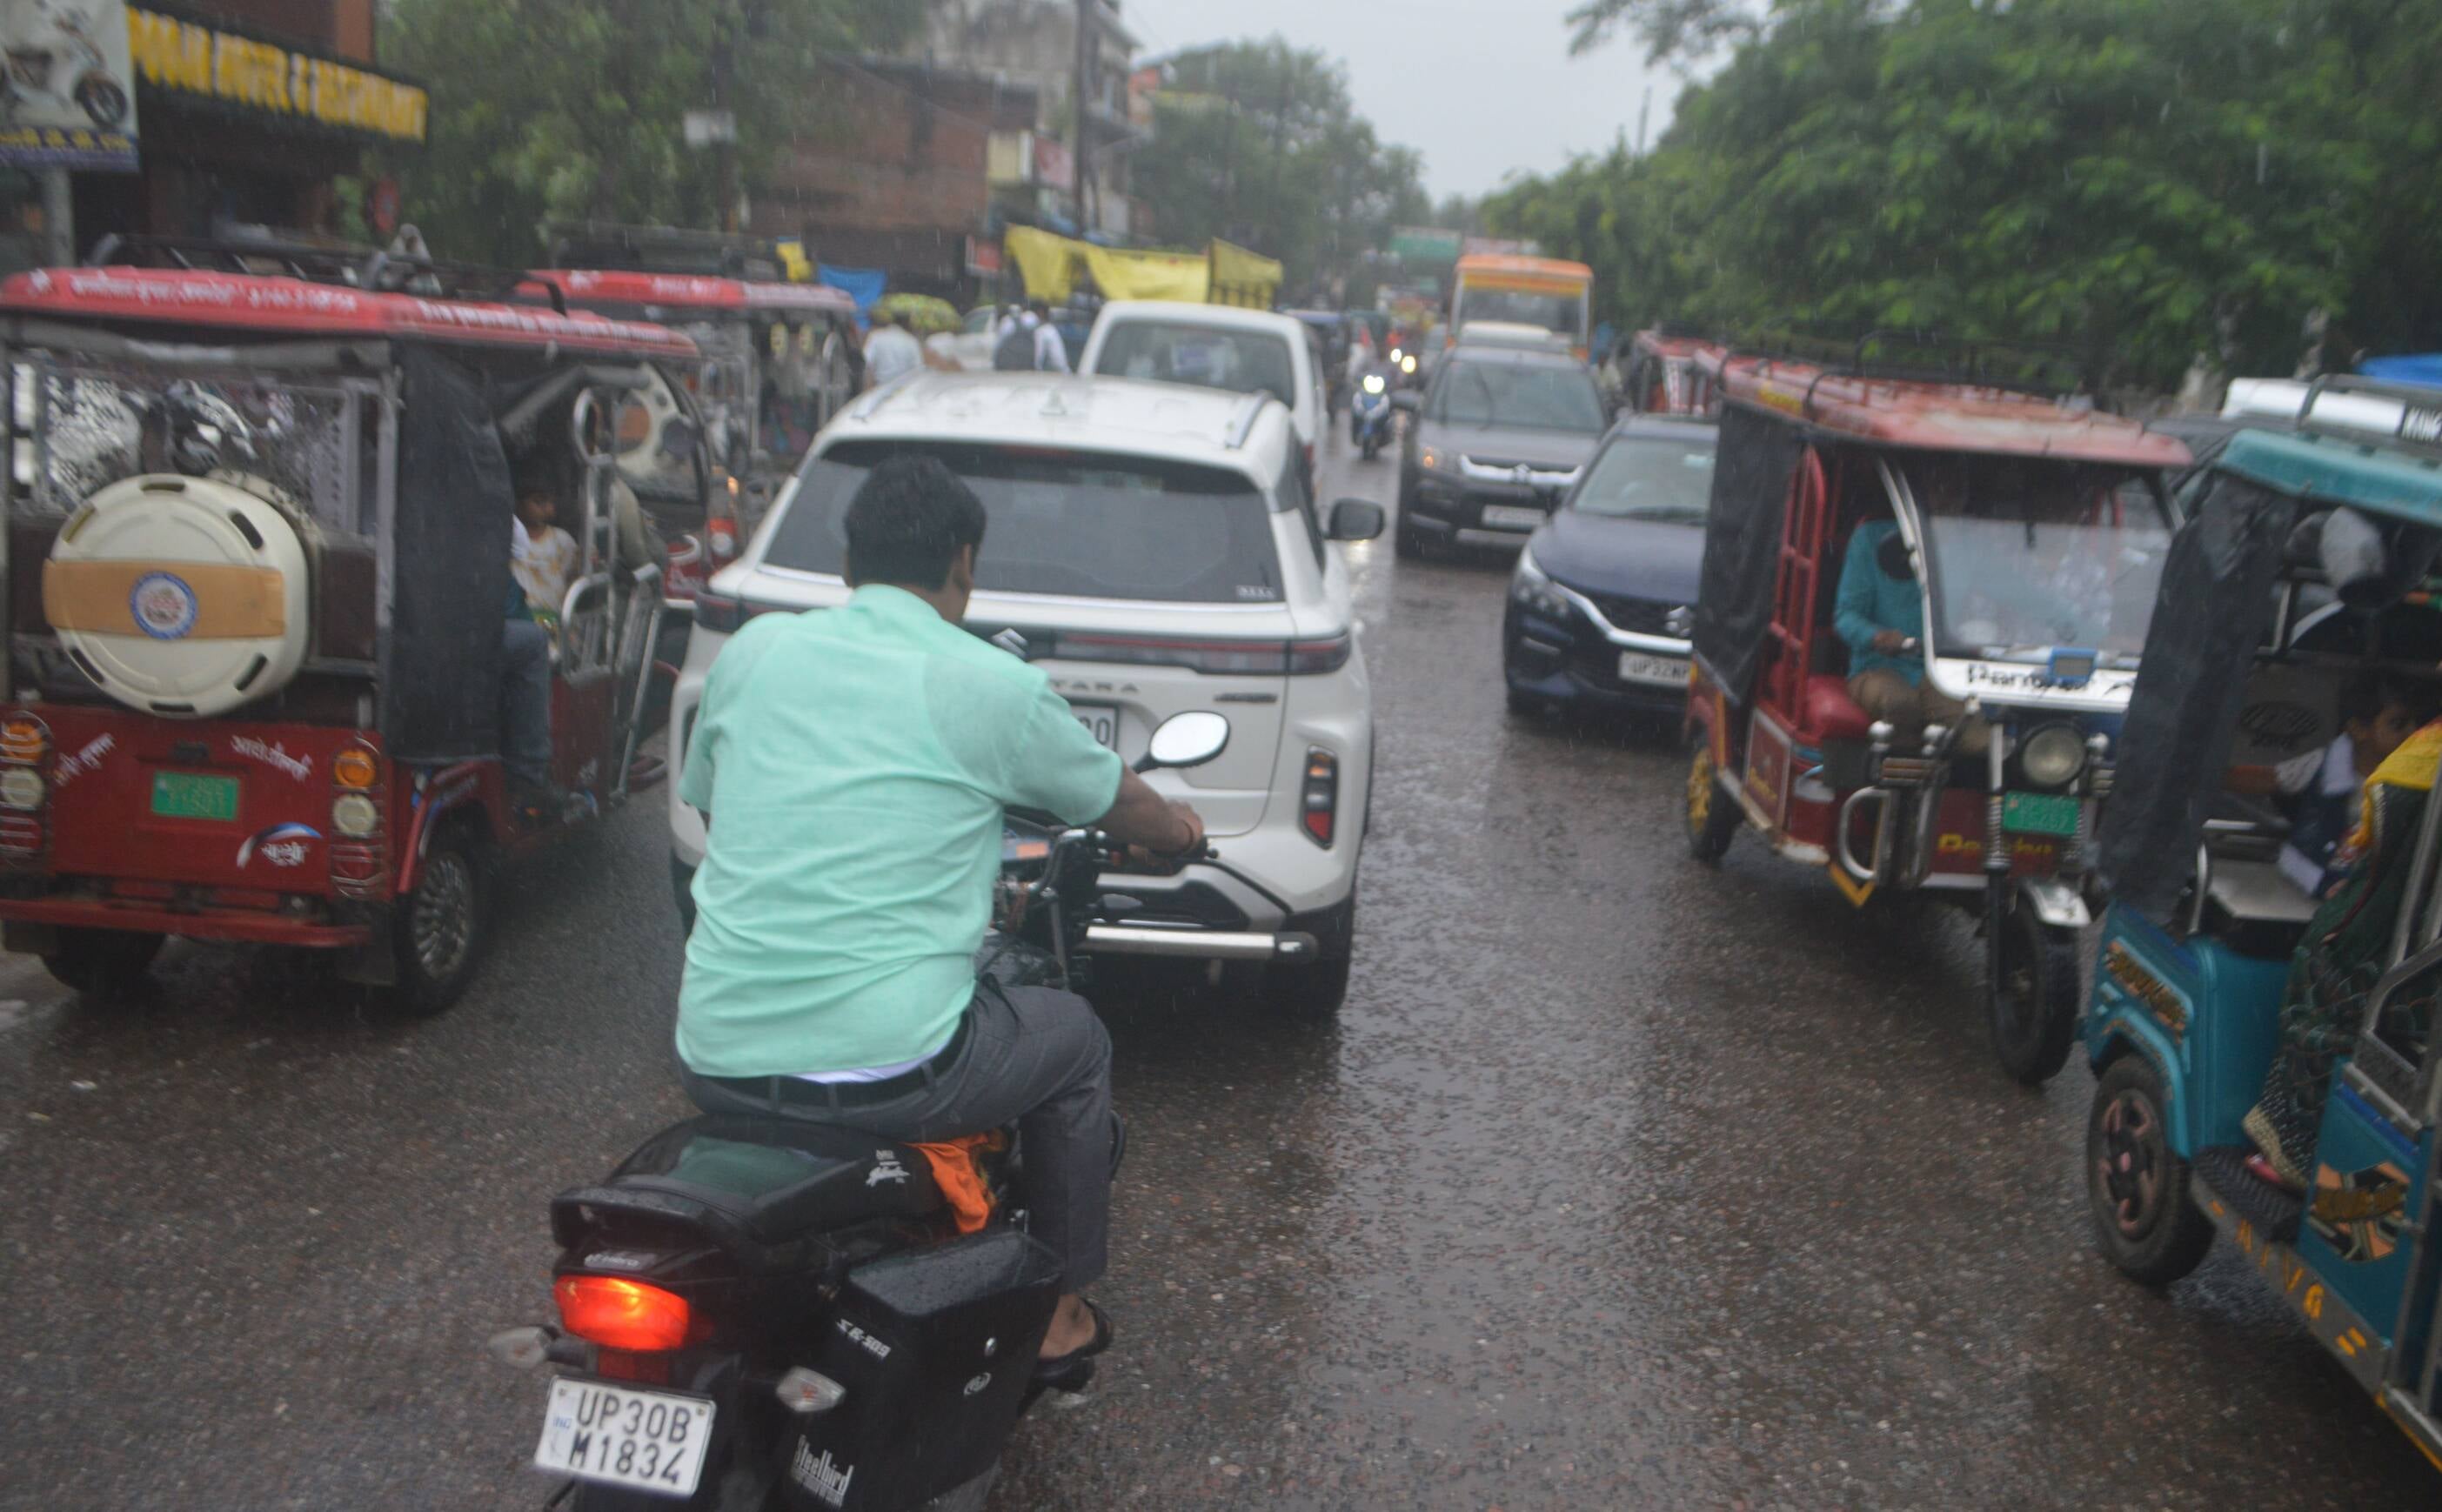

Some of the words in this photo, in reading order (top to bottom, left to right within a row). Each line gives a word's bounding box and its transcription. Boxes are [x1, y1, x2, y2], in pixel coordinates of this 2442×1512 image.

[576, 1389, 692, 1443] UP30B
[568, 1428, 686, 1485] M1834
[793, 1434, 855, 1496] Steelbird
